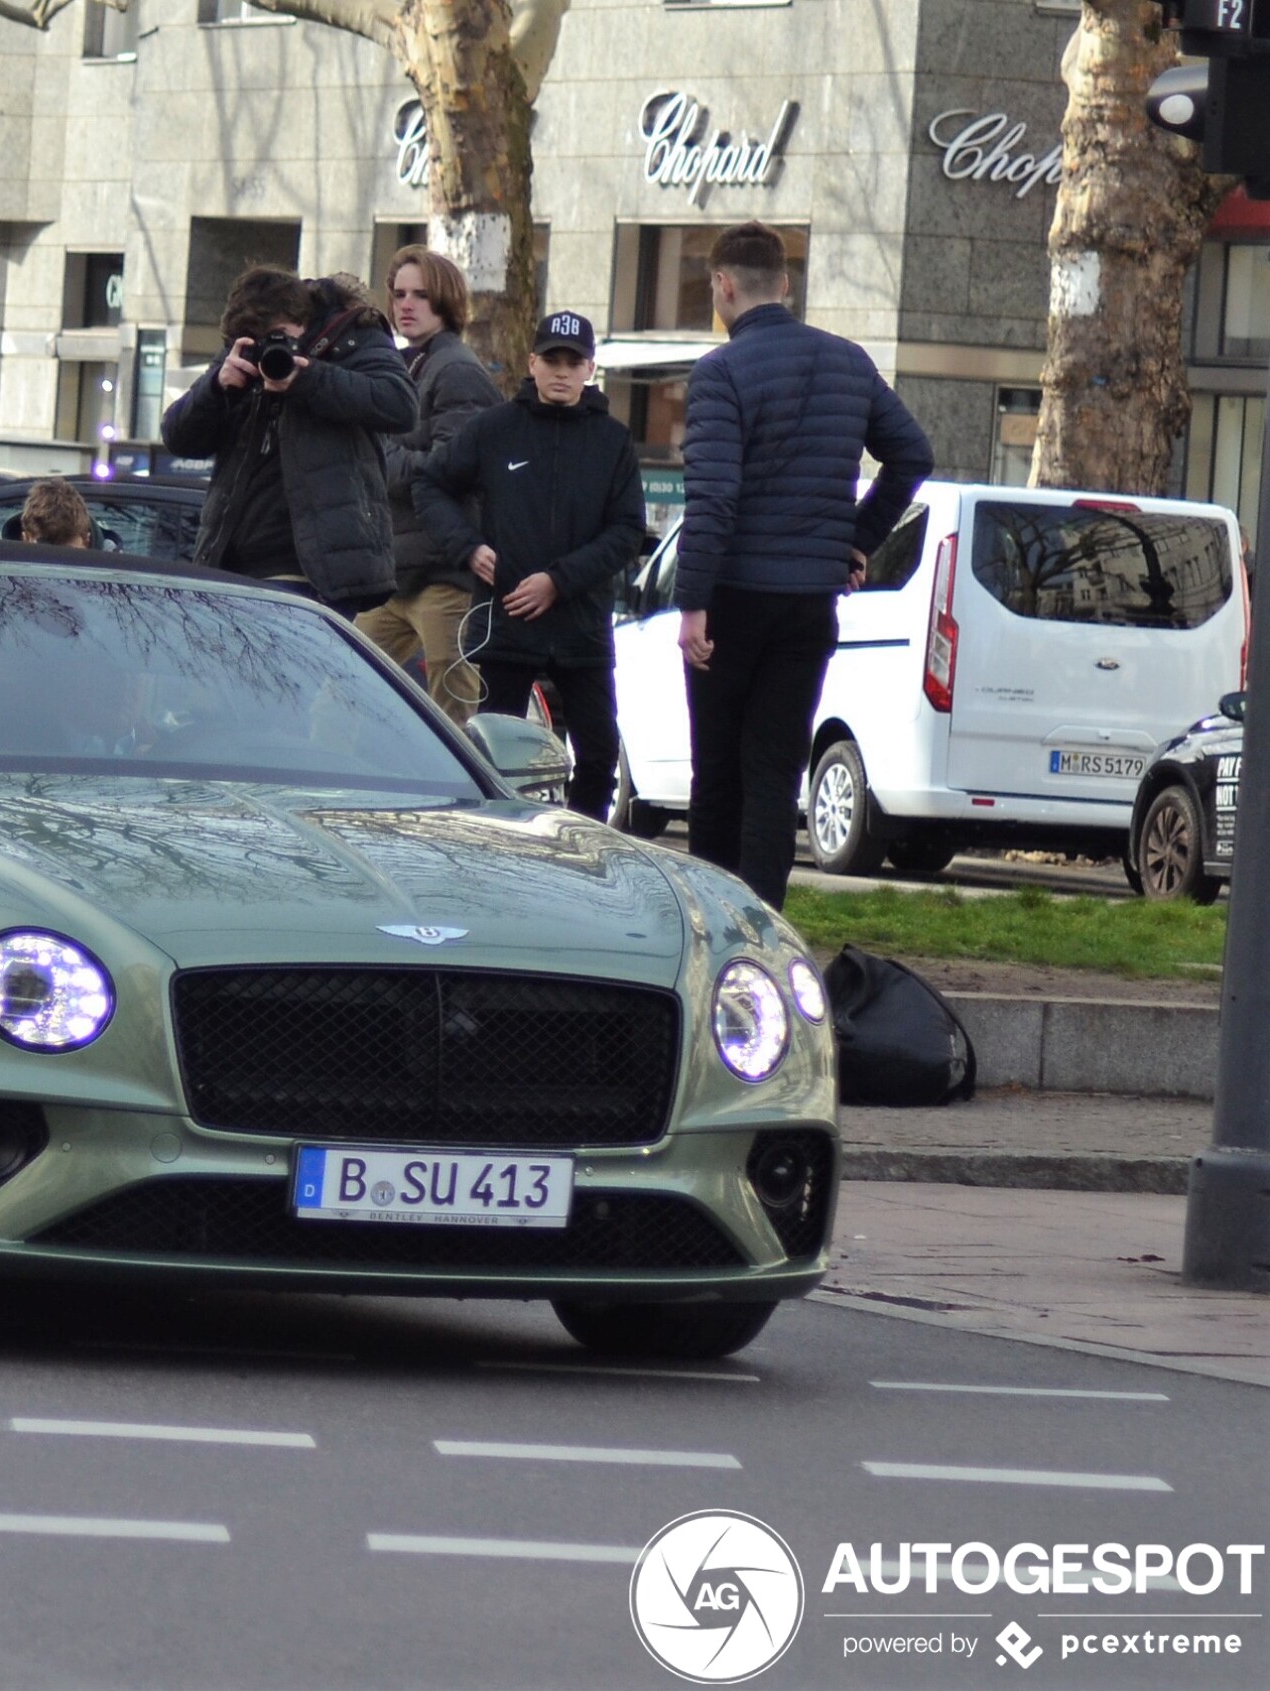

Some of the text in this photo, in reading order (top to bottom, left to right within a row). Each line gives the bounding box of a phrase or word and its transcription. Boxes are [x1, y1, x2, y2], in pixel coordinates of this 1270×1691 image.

[1217, 0, 1243, 29] F2
[638, 90, 788, 206] Chopard
[1061, 754, 1143, 776] M RS 5179
[304, 1157, 551, 1208] D B SU 413
[370, 1212, 499, 1225] BENTLEY HANNOVER
